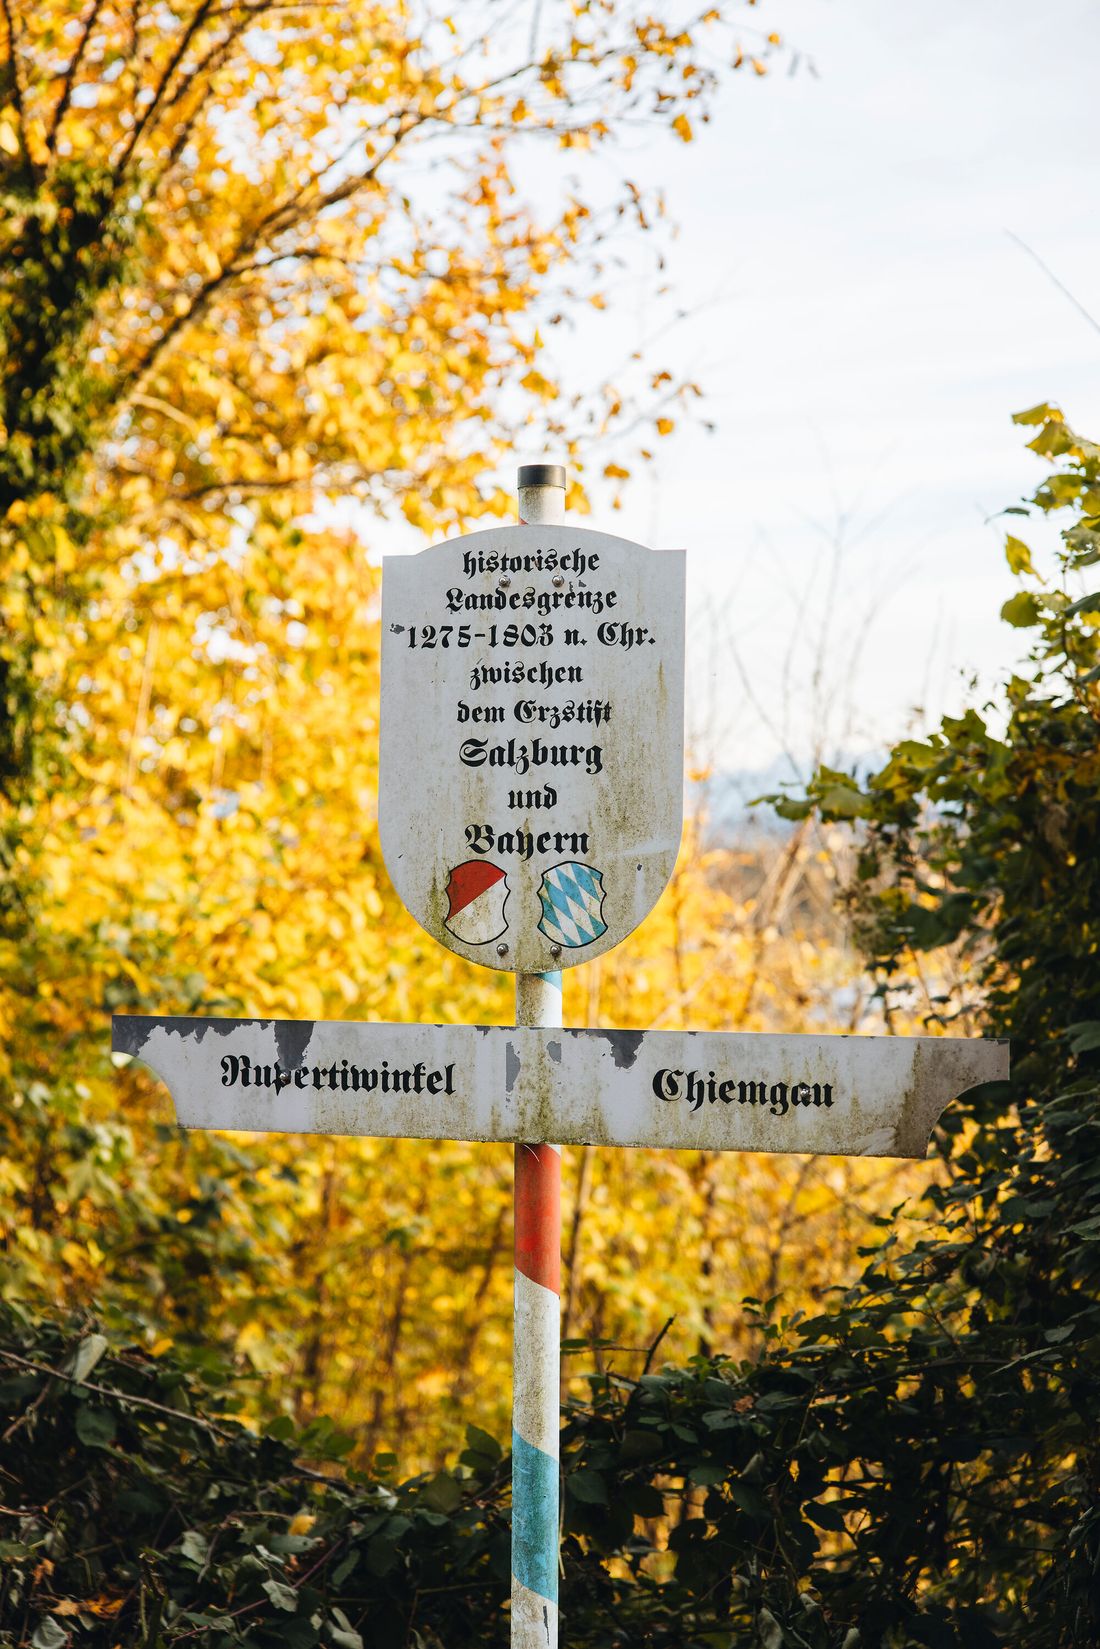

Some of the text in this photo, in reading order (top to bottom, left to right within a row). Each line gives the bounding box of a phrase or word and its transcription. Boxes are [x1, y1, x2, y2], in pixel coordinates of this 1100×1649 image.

[462, 548, 600, 580] historische
[445, 586, 618, 616] Landesgrenze
[407, 621, 656, 651] 1275-1803 n. Chr.
[469, 660, 584, 690] zwischen
[457, 699, 612, 729] dem Erzstift
[458, 738, 603, 775] Salzburg
[507, 782, 557, 810] und
[464, 824, 590, 862] Bayern
[220, 1054, 456, 1096] Rupertiwinkel
[652, 1068, 835, 1116] Chiemgau
